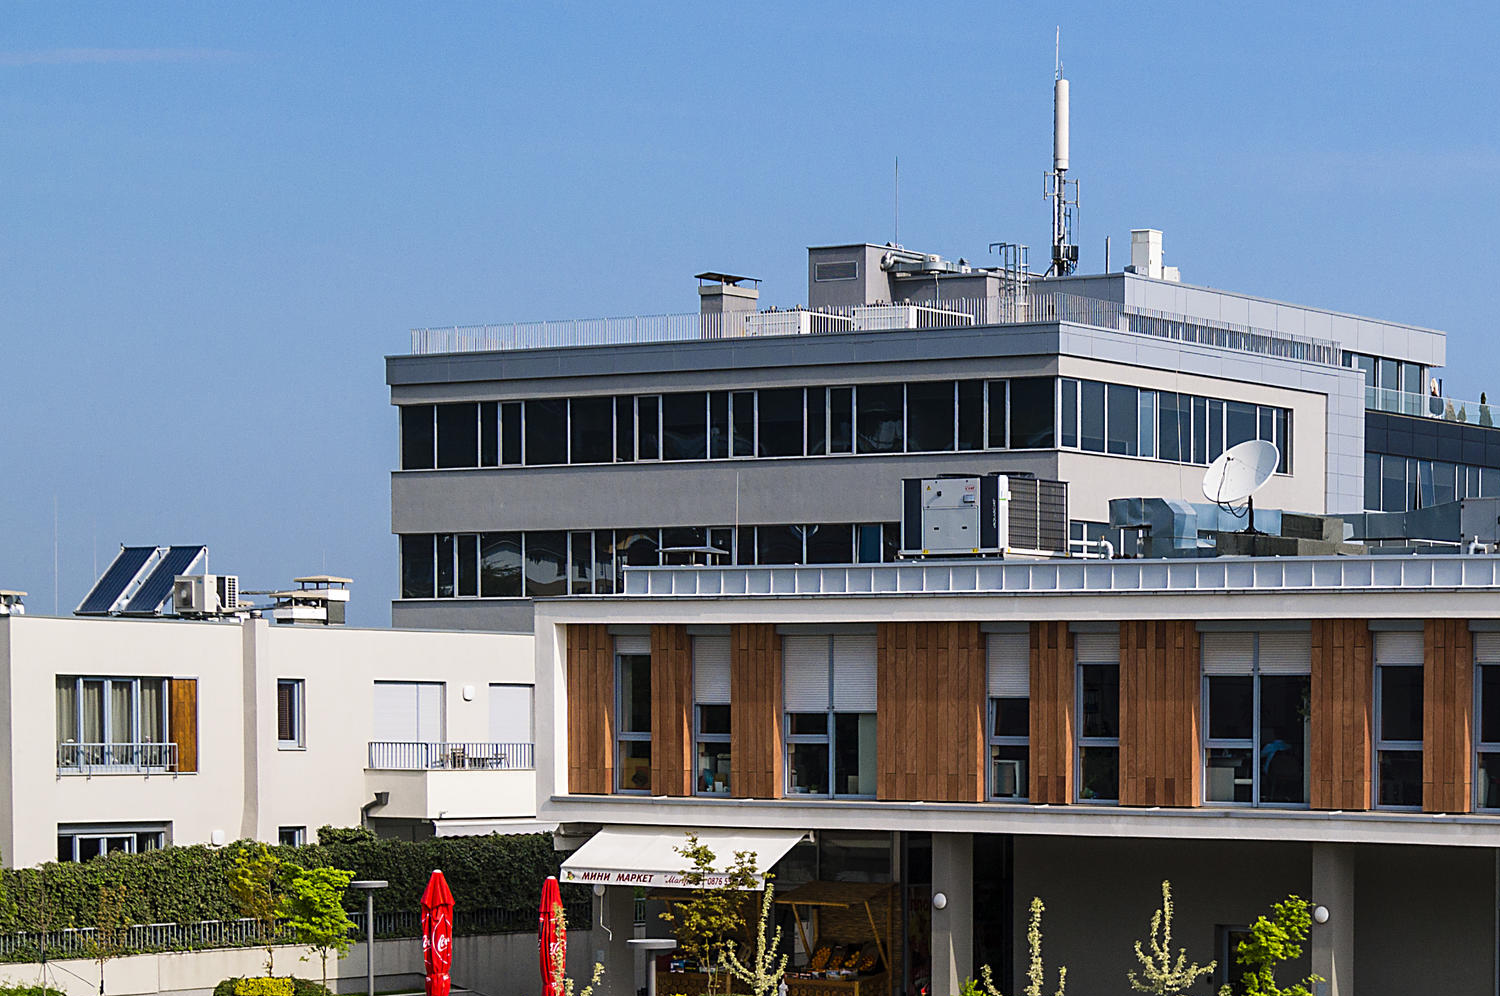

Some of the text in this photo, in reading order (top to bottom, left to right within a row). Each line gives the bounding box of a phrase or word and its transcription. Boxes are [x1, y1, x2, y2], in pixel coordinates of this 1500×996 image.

[581, 871, 611, 881] МИНИ
[616, 873, 654, 883] МАРКЕТ
[707, 877, 723, 886] 0876
